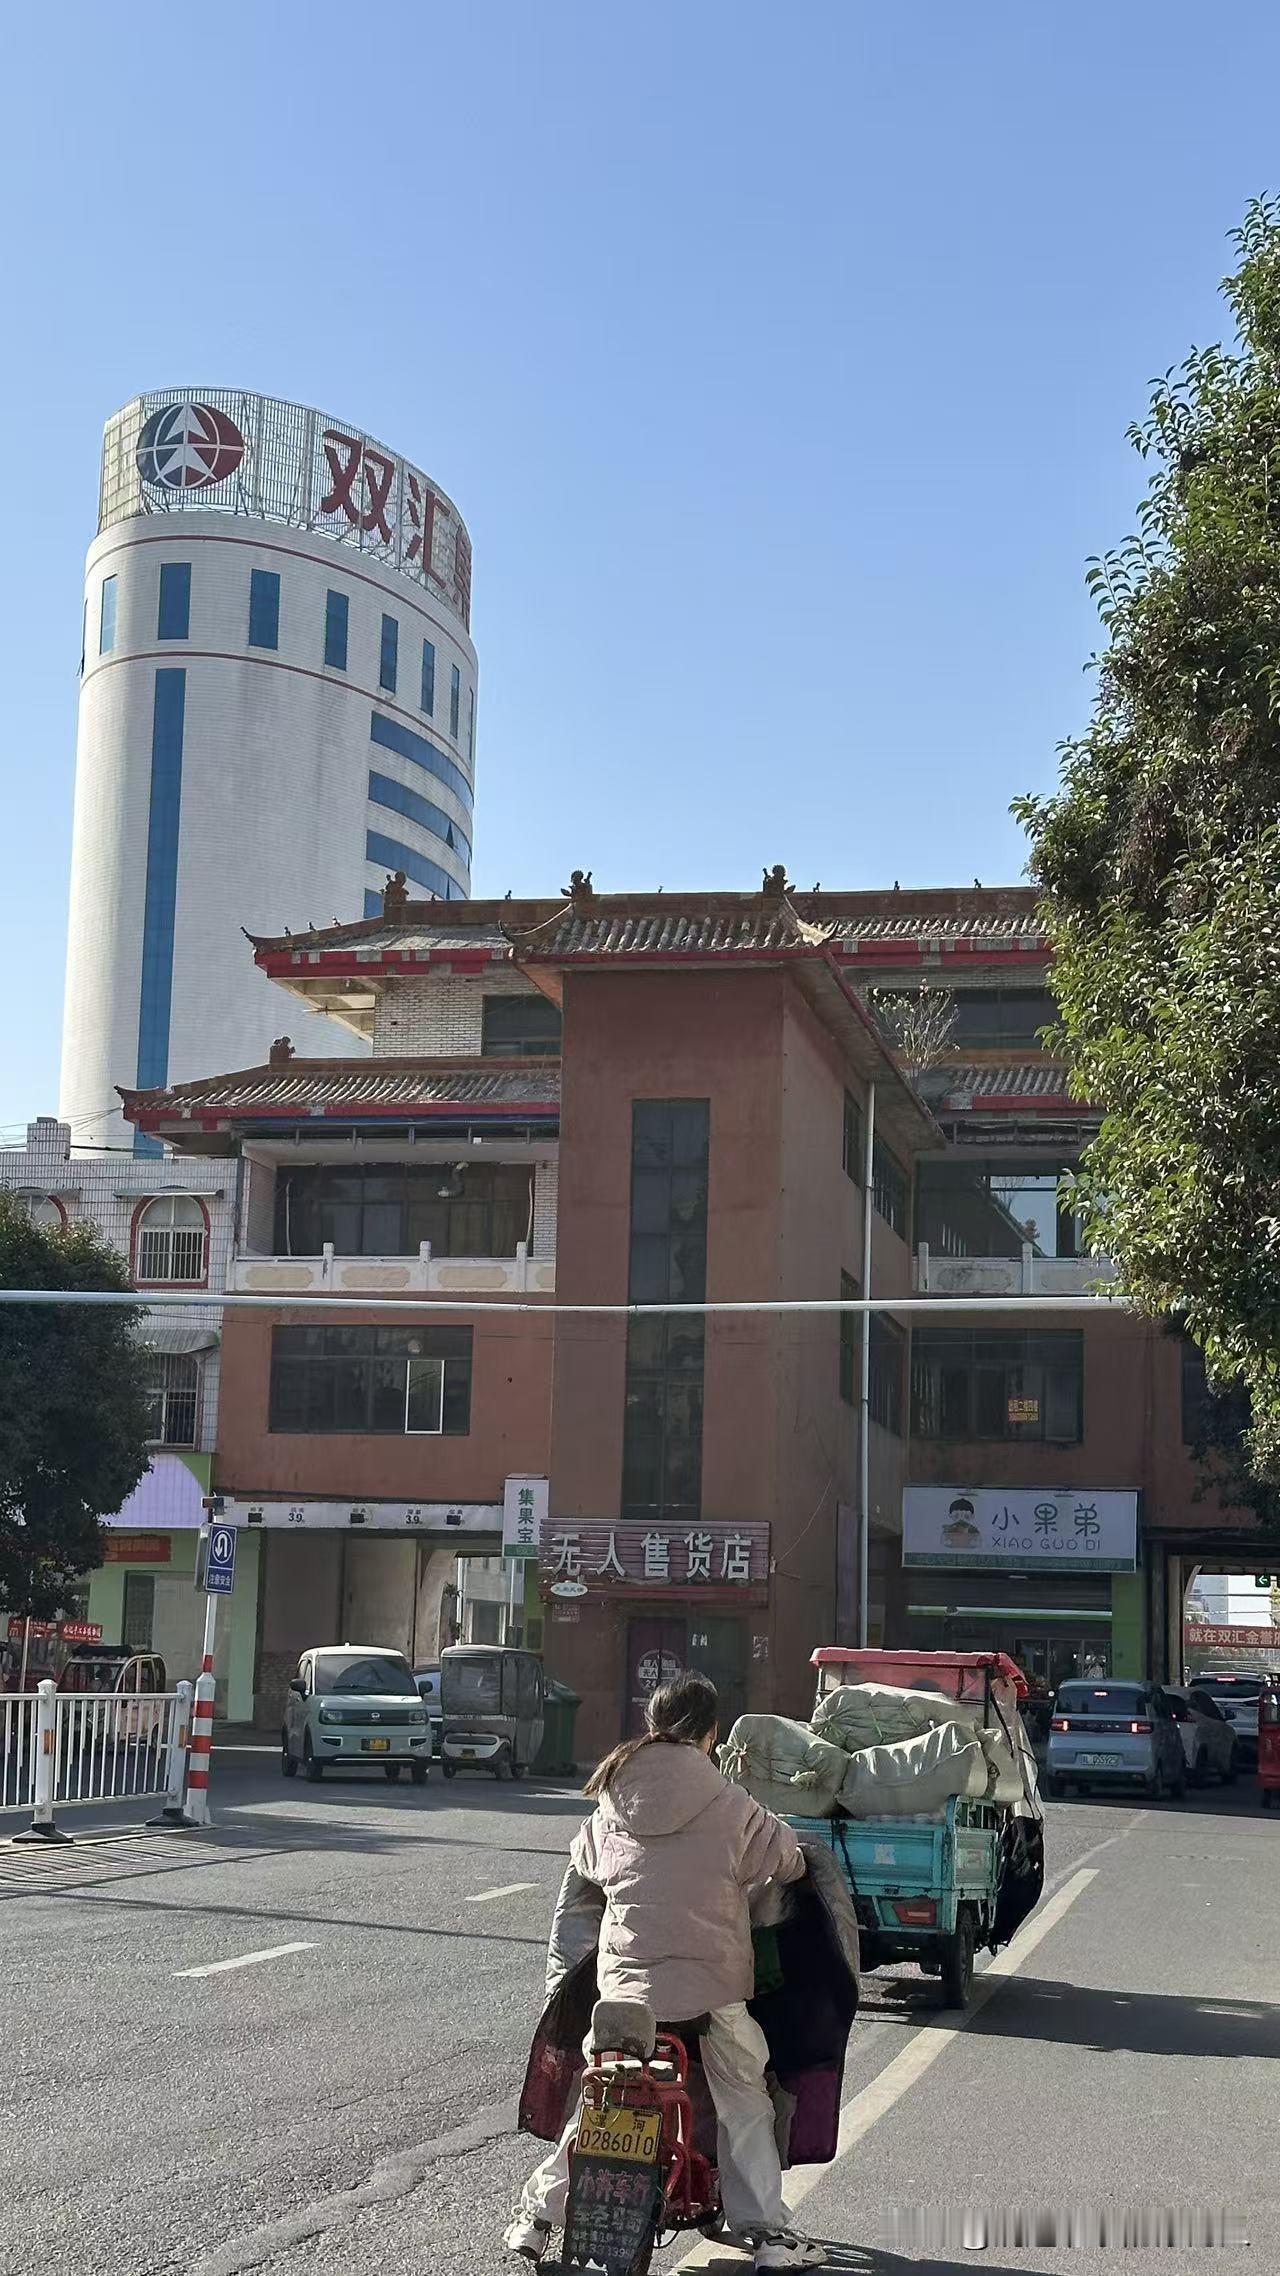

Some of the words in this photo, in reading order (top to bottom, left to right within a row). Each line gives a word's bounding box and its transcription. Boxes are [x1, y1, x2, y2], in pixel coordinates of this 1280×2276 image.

[517, 1487, 535, 1544] 集果宝
[991, 1502, 1101, 1537] 小果弟
[551, 1531, 753, 1580] 无人售货店
[991, 1536, 1033, 1550] XIAO
[1040, 1538, 1078, 1551] GUO
[1085, 1539, 1101, 1551] DI
[580, 2129, 654, 2156] 0286010
